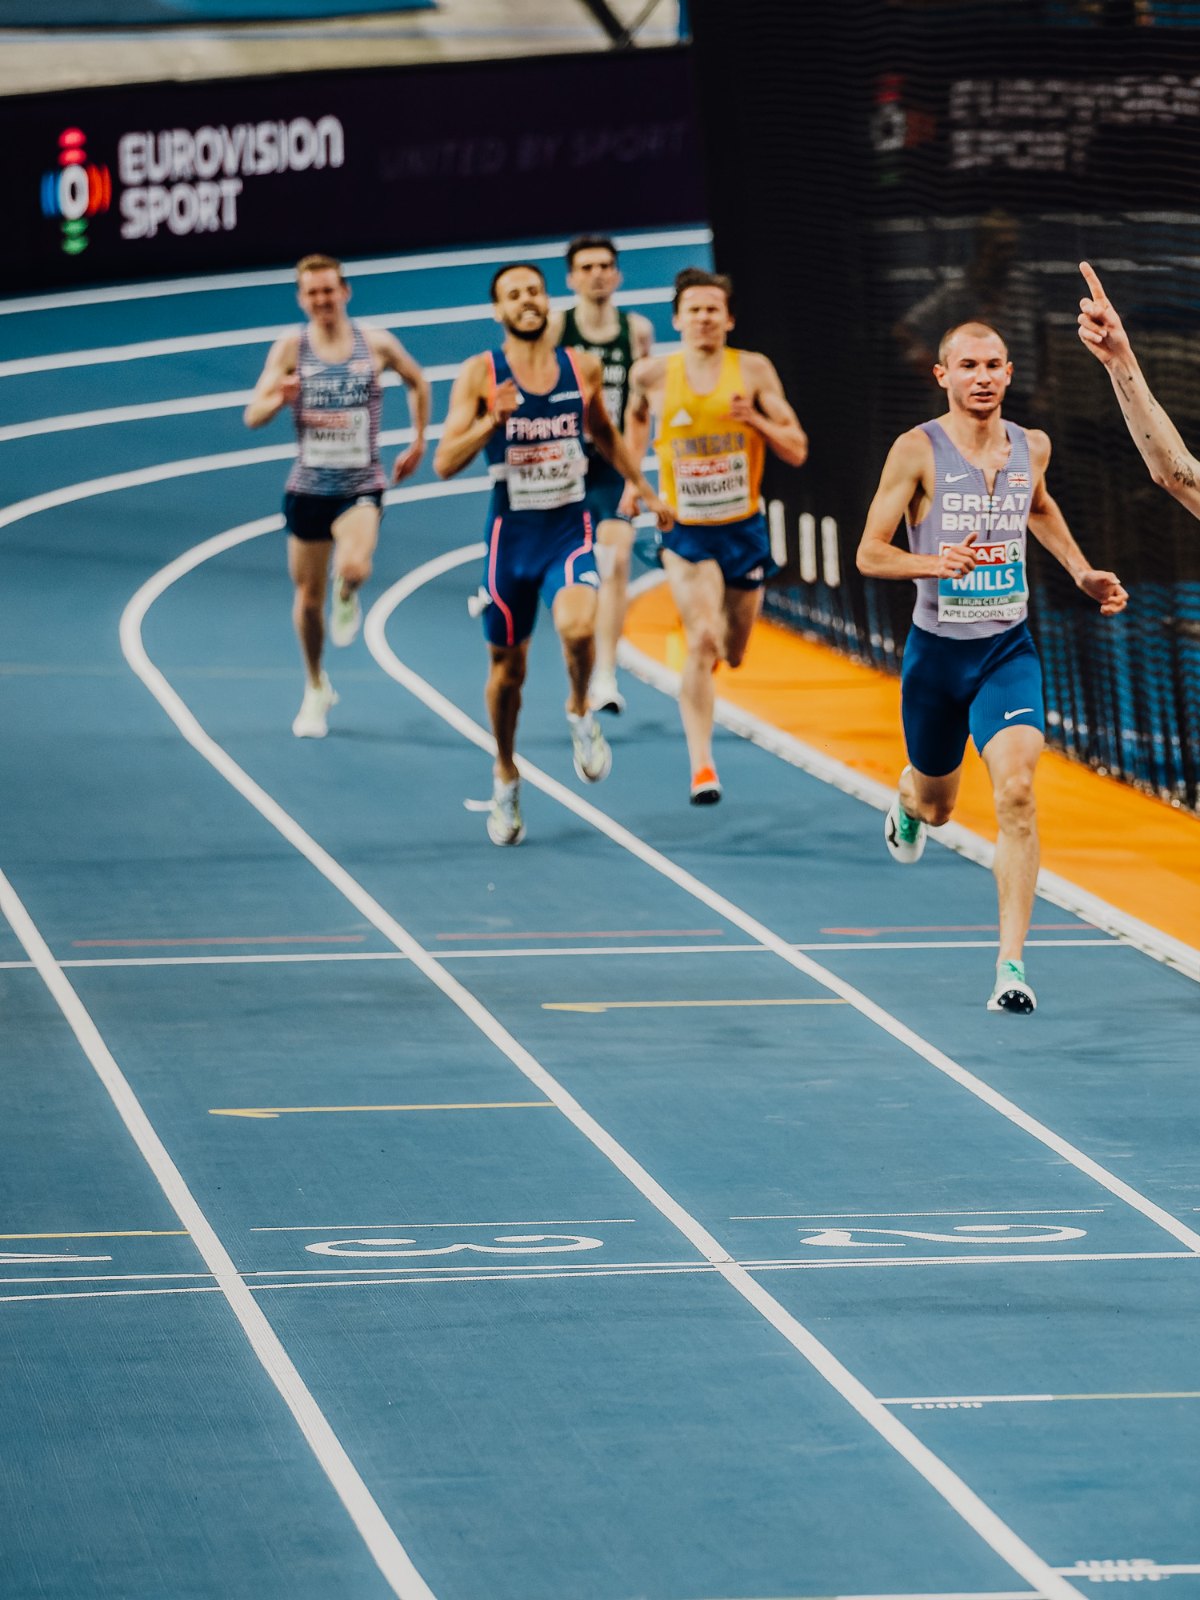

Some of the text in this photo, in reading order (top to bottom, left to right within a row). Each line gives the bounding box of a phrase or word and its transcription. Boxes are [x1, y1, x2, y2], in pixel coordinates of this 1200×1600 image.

[118, 114, 345, 186] EUROVISION
[119, 177, 243, 240] SPORT
[506, 412, 579, 441] FRANCE
[942, 492, 1028, 512] GREAT
[942, 512, 1024, 531] BRITAIN
[951, 568, 1015, 591] MILLS
[942, 606, 1023, 619] APELDOORN 202
